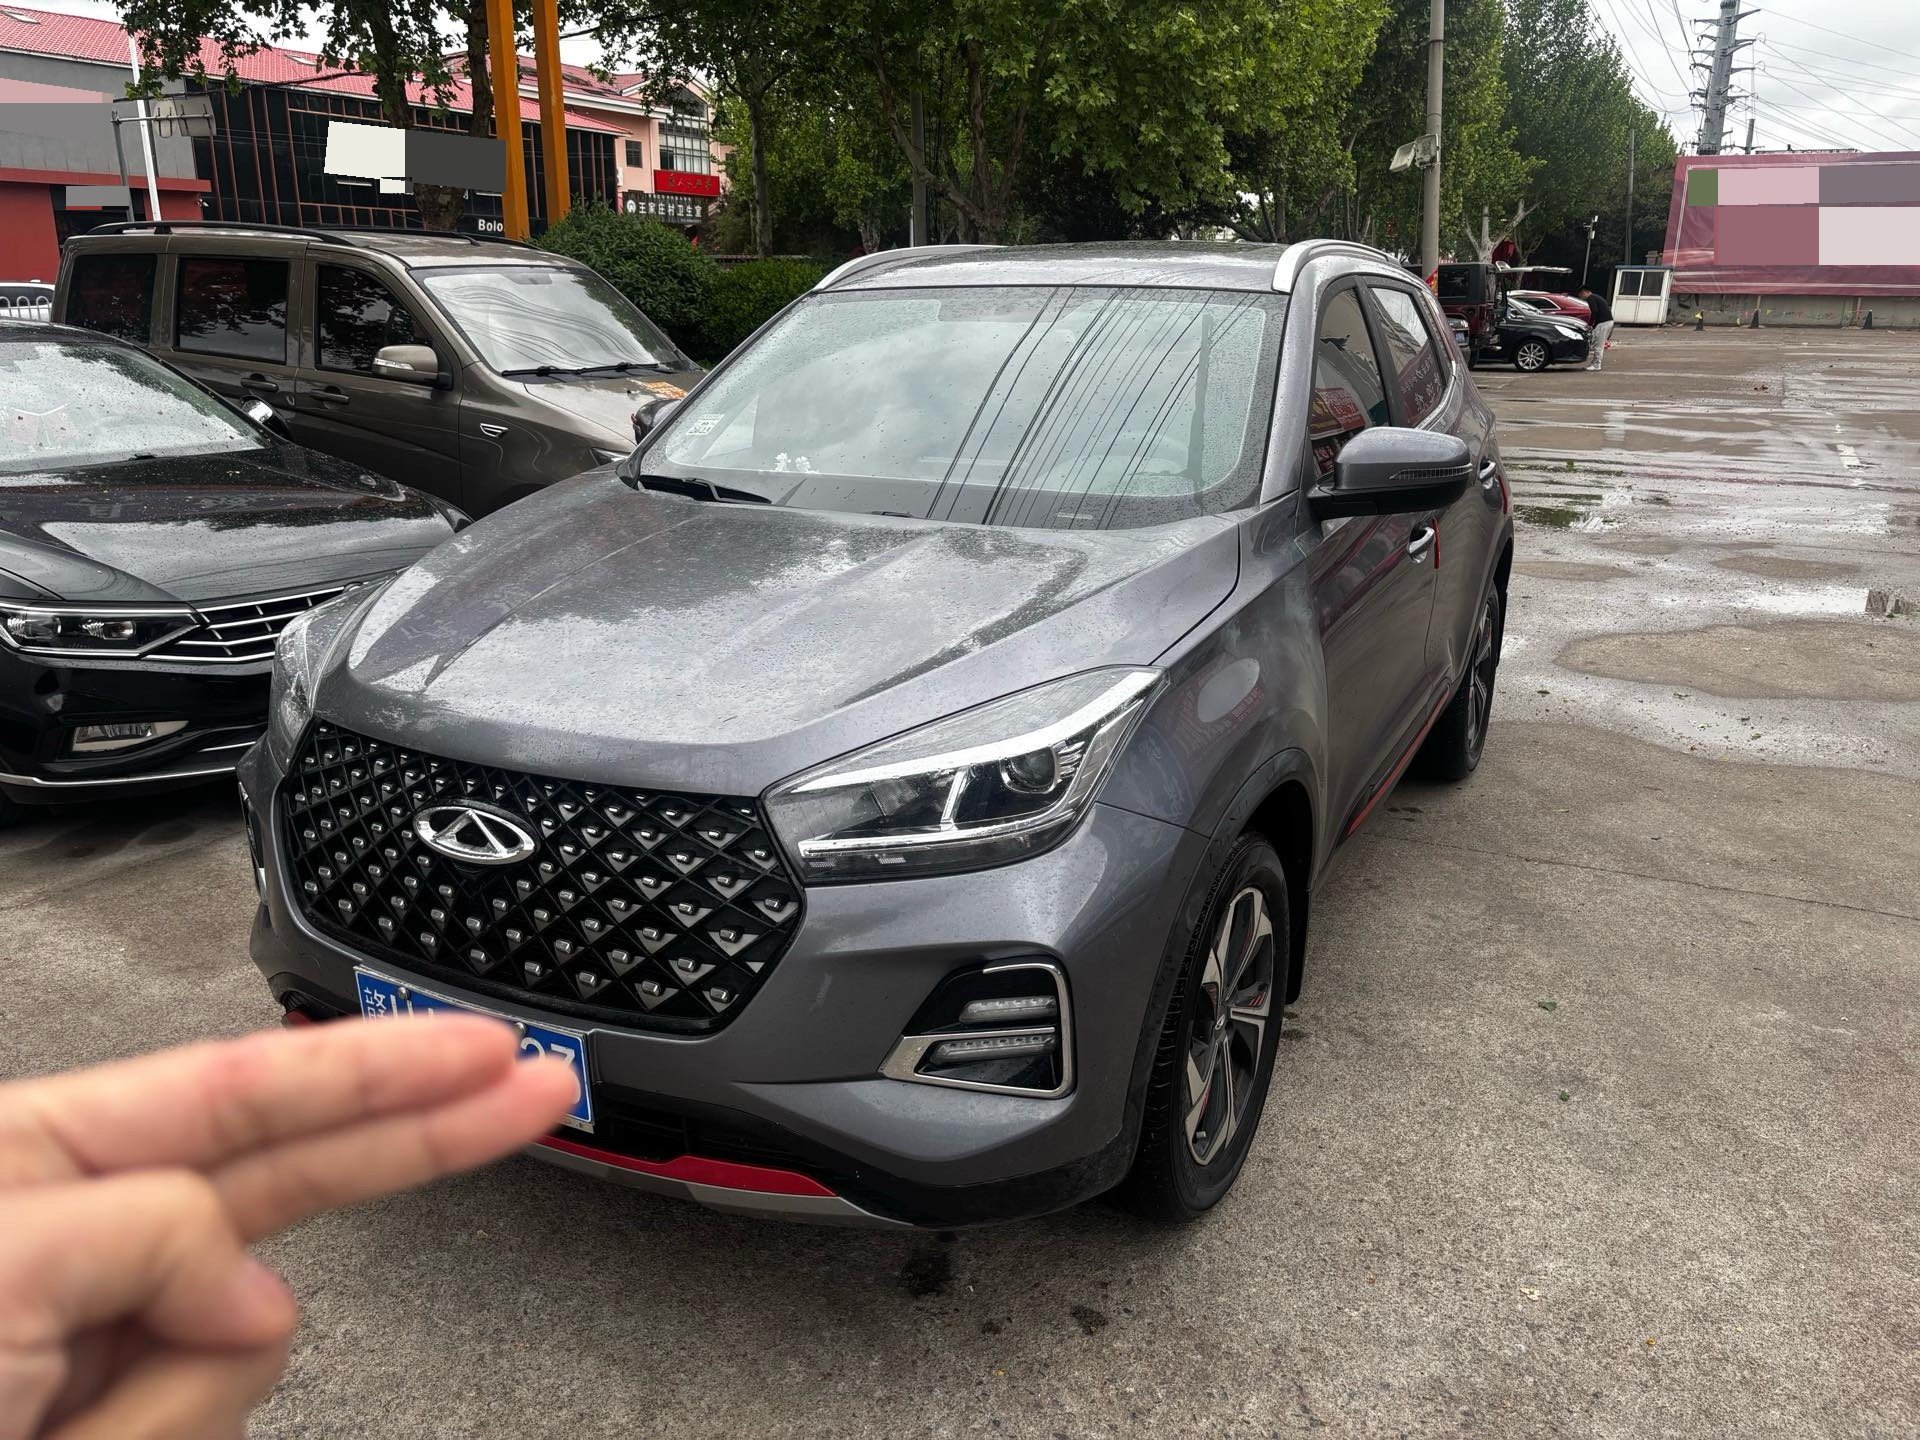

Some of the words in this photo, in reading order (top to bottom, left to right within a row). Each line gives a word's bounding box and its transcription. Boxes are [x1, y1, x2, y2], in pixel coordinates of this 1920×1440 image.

[638, 201, 702, 218] 王家庄村卫生室
[478, 218, 504, 232] Bolo
